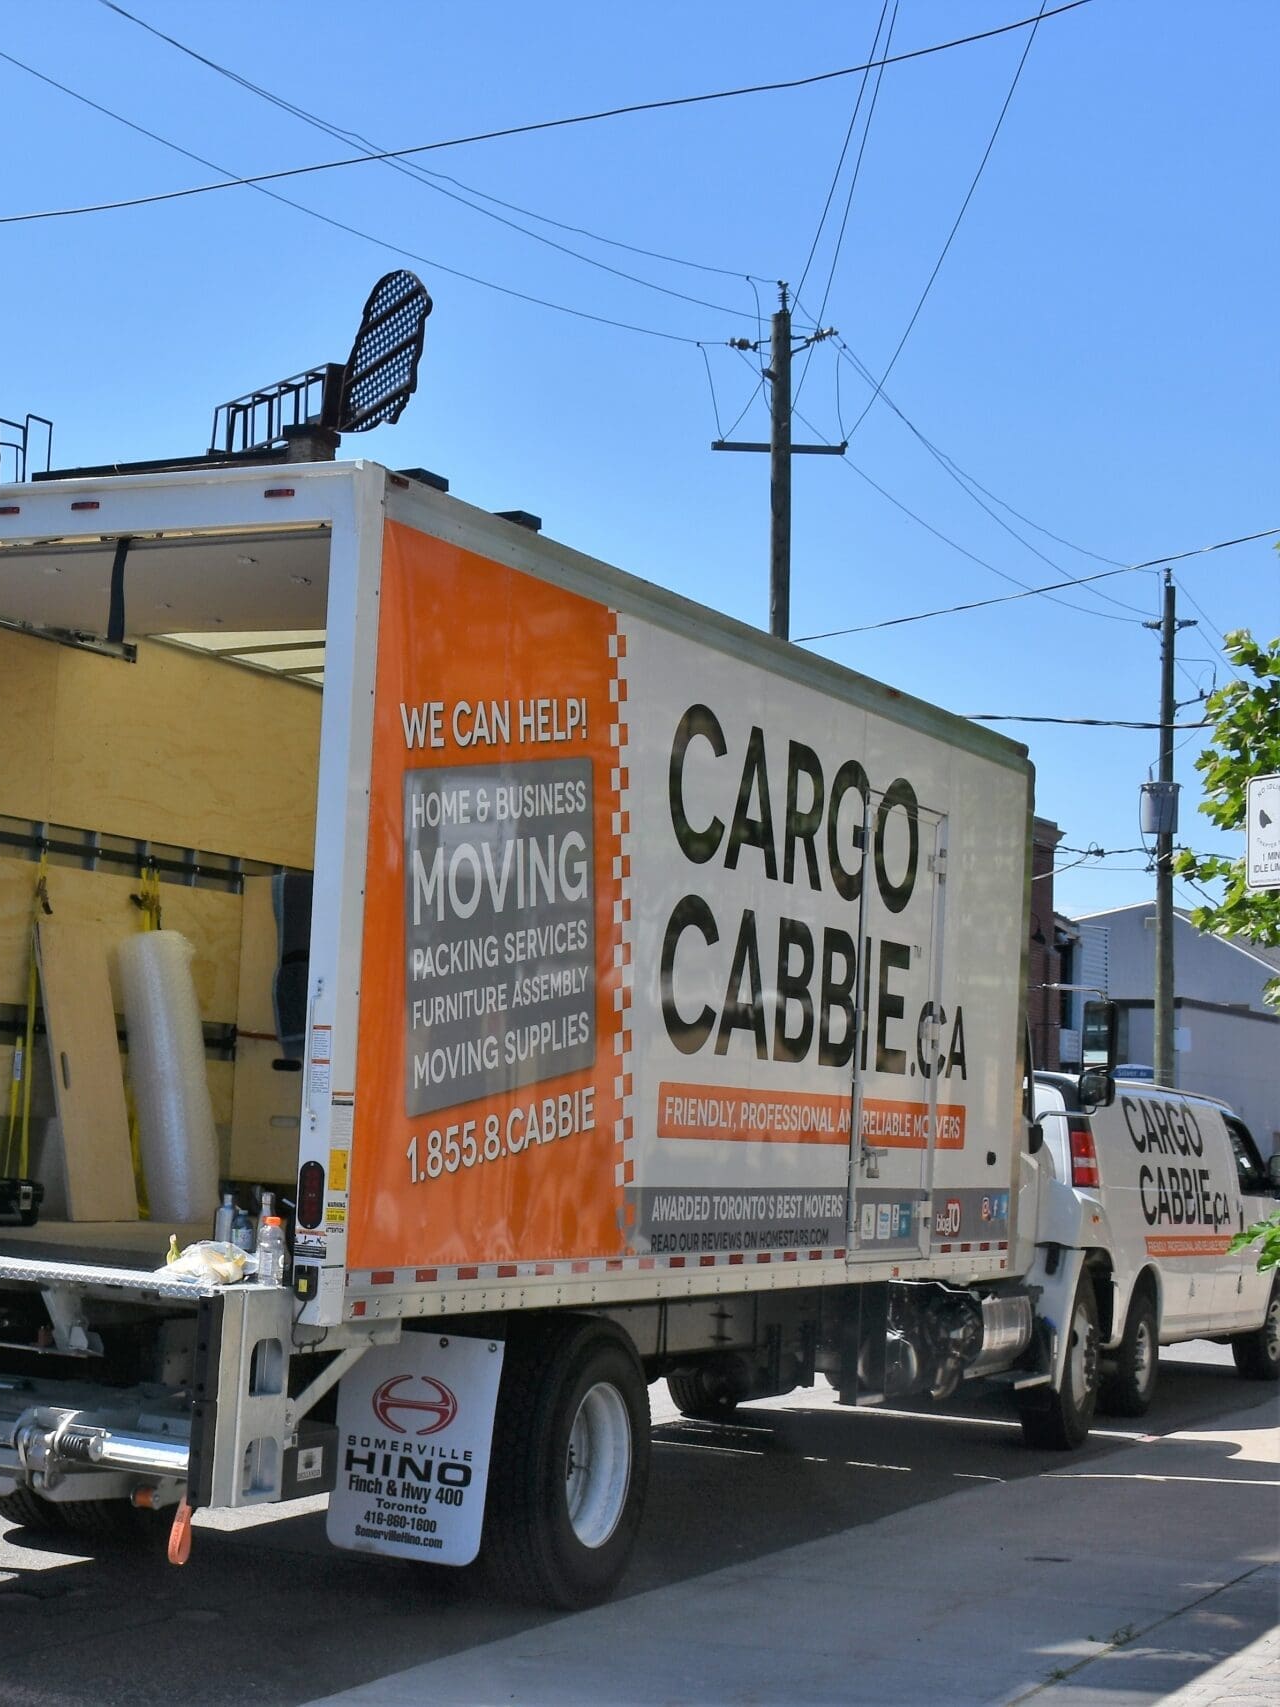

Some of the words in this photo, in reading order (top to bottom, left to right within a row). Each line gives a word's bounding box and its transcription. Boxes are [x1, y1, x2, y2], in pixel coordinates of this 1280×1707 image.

[400, 702, 445, 749] WE
[452, 700, 510, 747] CAN
[519, 697, 587, 742] HELP!
[412, 788, 470, 828] HOME
[476, 788, 490, 822] &
[496, 780, 586, 821] BUSINESS
[669, 704, 919, 914] CARGO
[413, 830, 588, 926] MOVING
[413, 935, 498, 982] PACKING
[504, 919, 587, 964] SERVICES
[413, 983, 507, 1030] FURNITURE
[512, 966, 589, 1009] ASSEMBLY
[660, 894, 967, 1080] CABBIE.CA
[414, 1035, 499, 1089] MOVING
[504, 1011, 589, 1066] SUPPLIES
[406, 1086, 595, 1184] 1.855.8.CABBIE
[665, 1096, 736, 1132] FRIENDLY,
[740, 1102, 834, 1133] PROFESSIONAL
[861, 1110, 910, 1136] RELIABLE
[913, 1115, 960, 1139] MOVERS
[1121, 1096, 1203, 1157] CARGO
[651, 1196, 710, 1221] AWARDED
[713, 1195, 775, 1221] TORONTO'S
[776, 1195, 803, 1219] BEST
[804, 1194, 843, 1219] MOVERS
[936, 1203, 960, 1235] blogTO
[651, 1232, 677, 1251] READ
[679, 1232, 700, 1251] OUR
[702, 1231, 742, 1250] REVIEWS
[744, 1230, 757, 1248] ON
[345, 1449, 472, 1487] HINO
[348, 1435, 472, 1461] SOMERVILLE
[348, 1474, 382, 1494] Finch
[386, 1480, 397, 1497] &
[401, 1482, 431, 1504] Hwy
[435, 1487, 463, 1506] 400
[376, 1498, 427, 1515] Toronto
